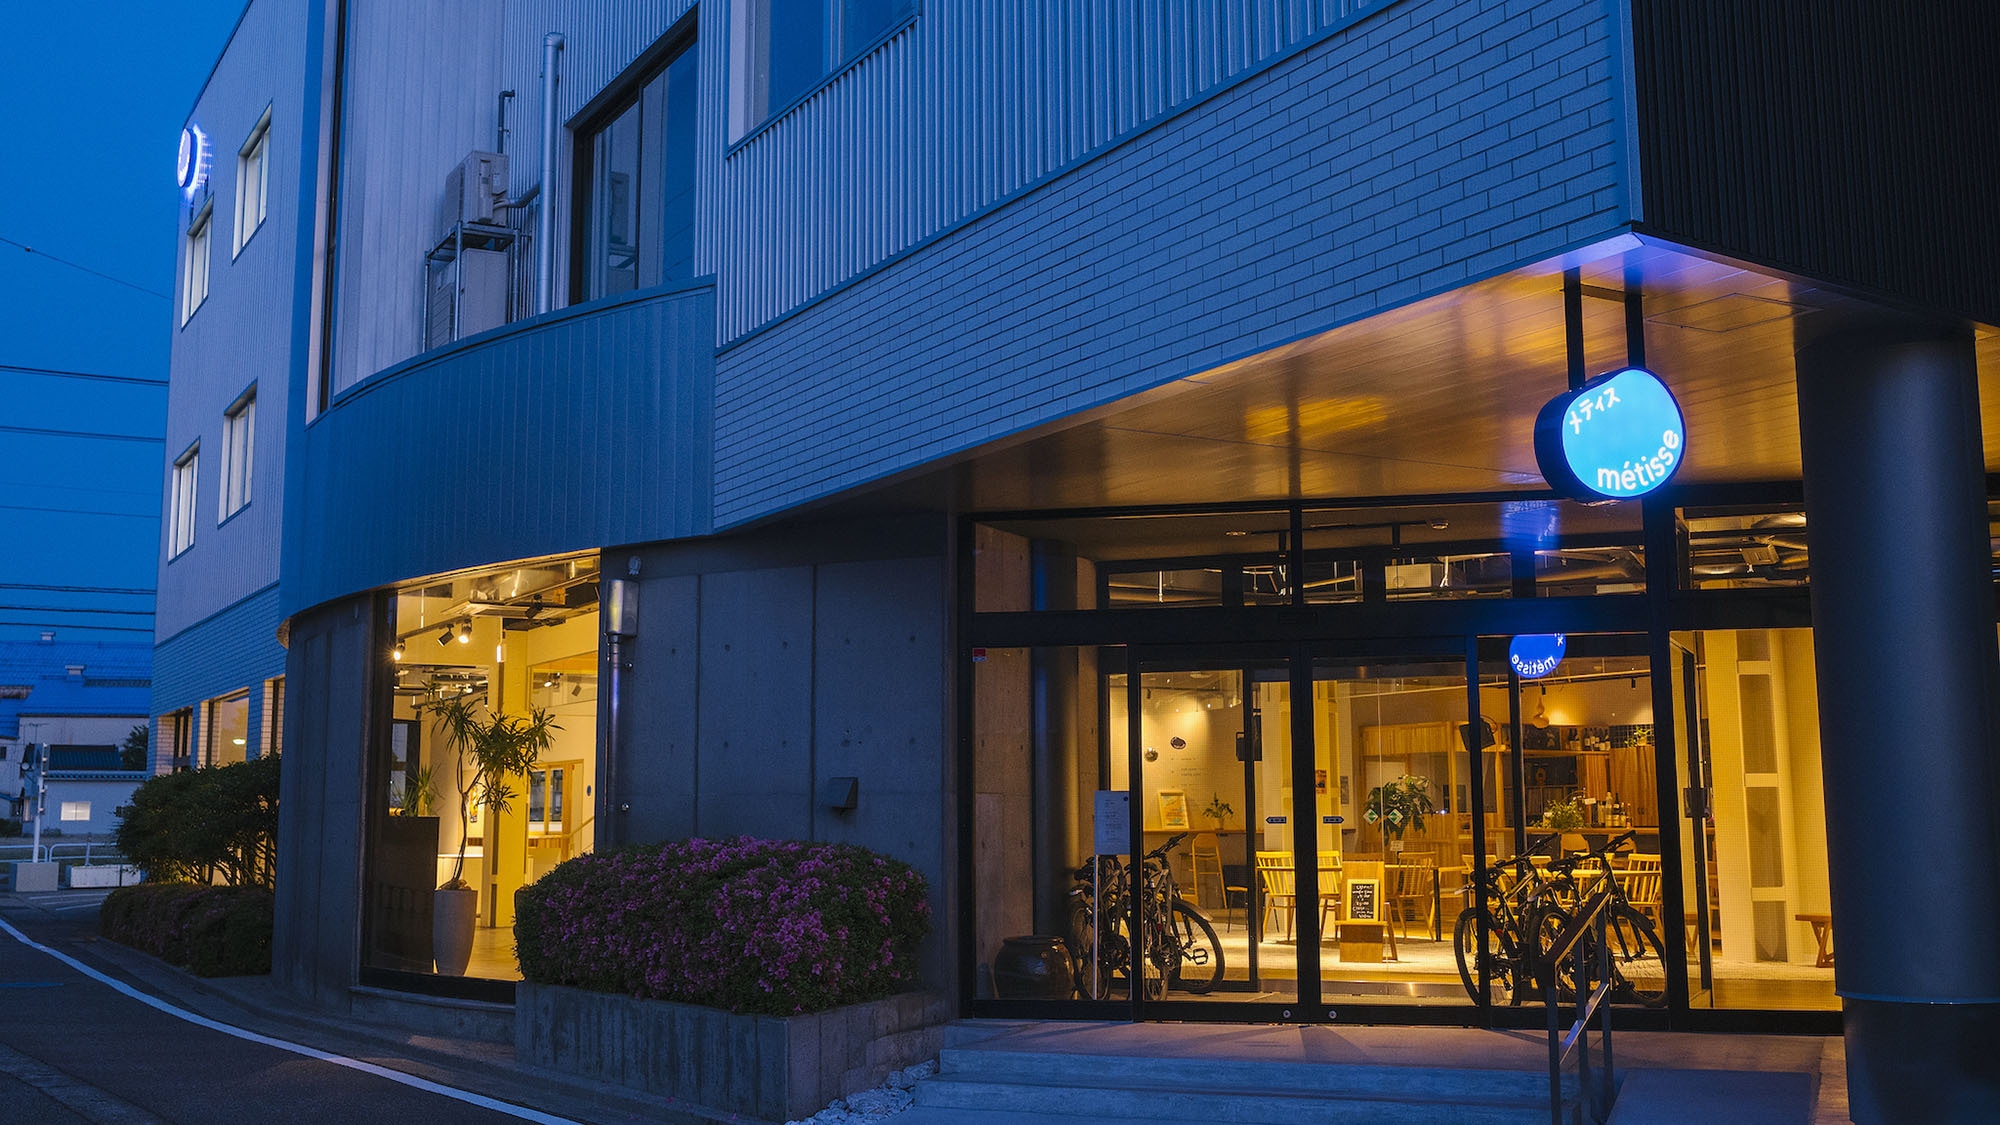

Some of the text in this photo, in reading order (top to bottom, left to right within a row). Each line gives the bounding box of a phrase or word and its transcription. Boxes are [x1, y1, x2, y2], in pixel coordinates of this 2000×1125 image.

[1570, 388, 1621, 434] メティス
[1598, 430, 1679, 490] métisse
